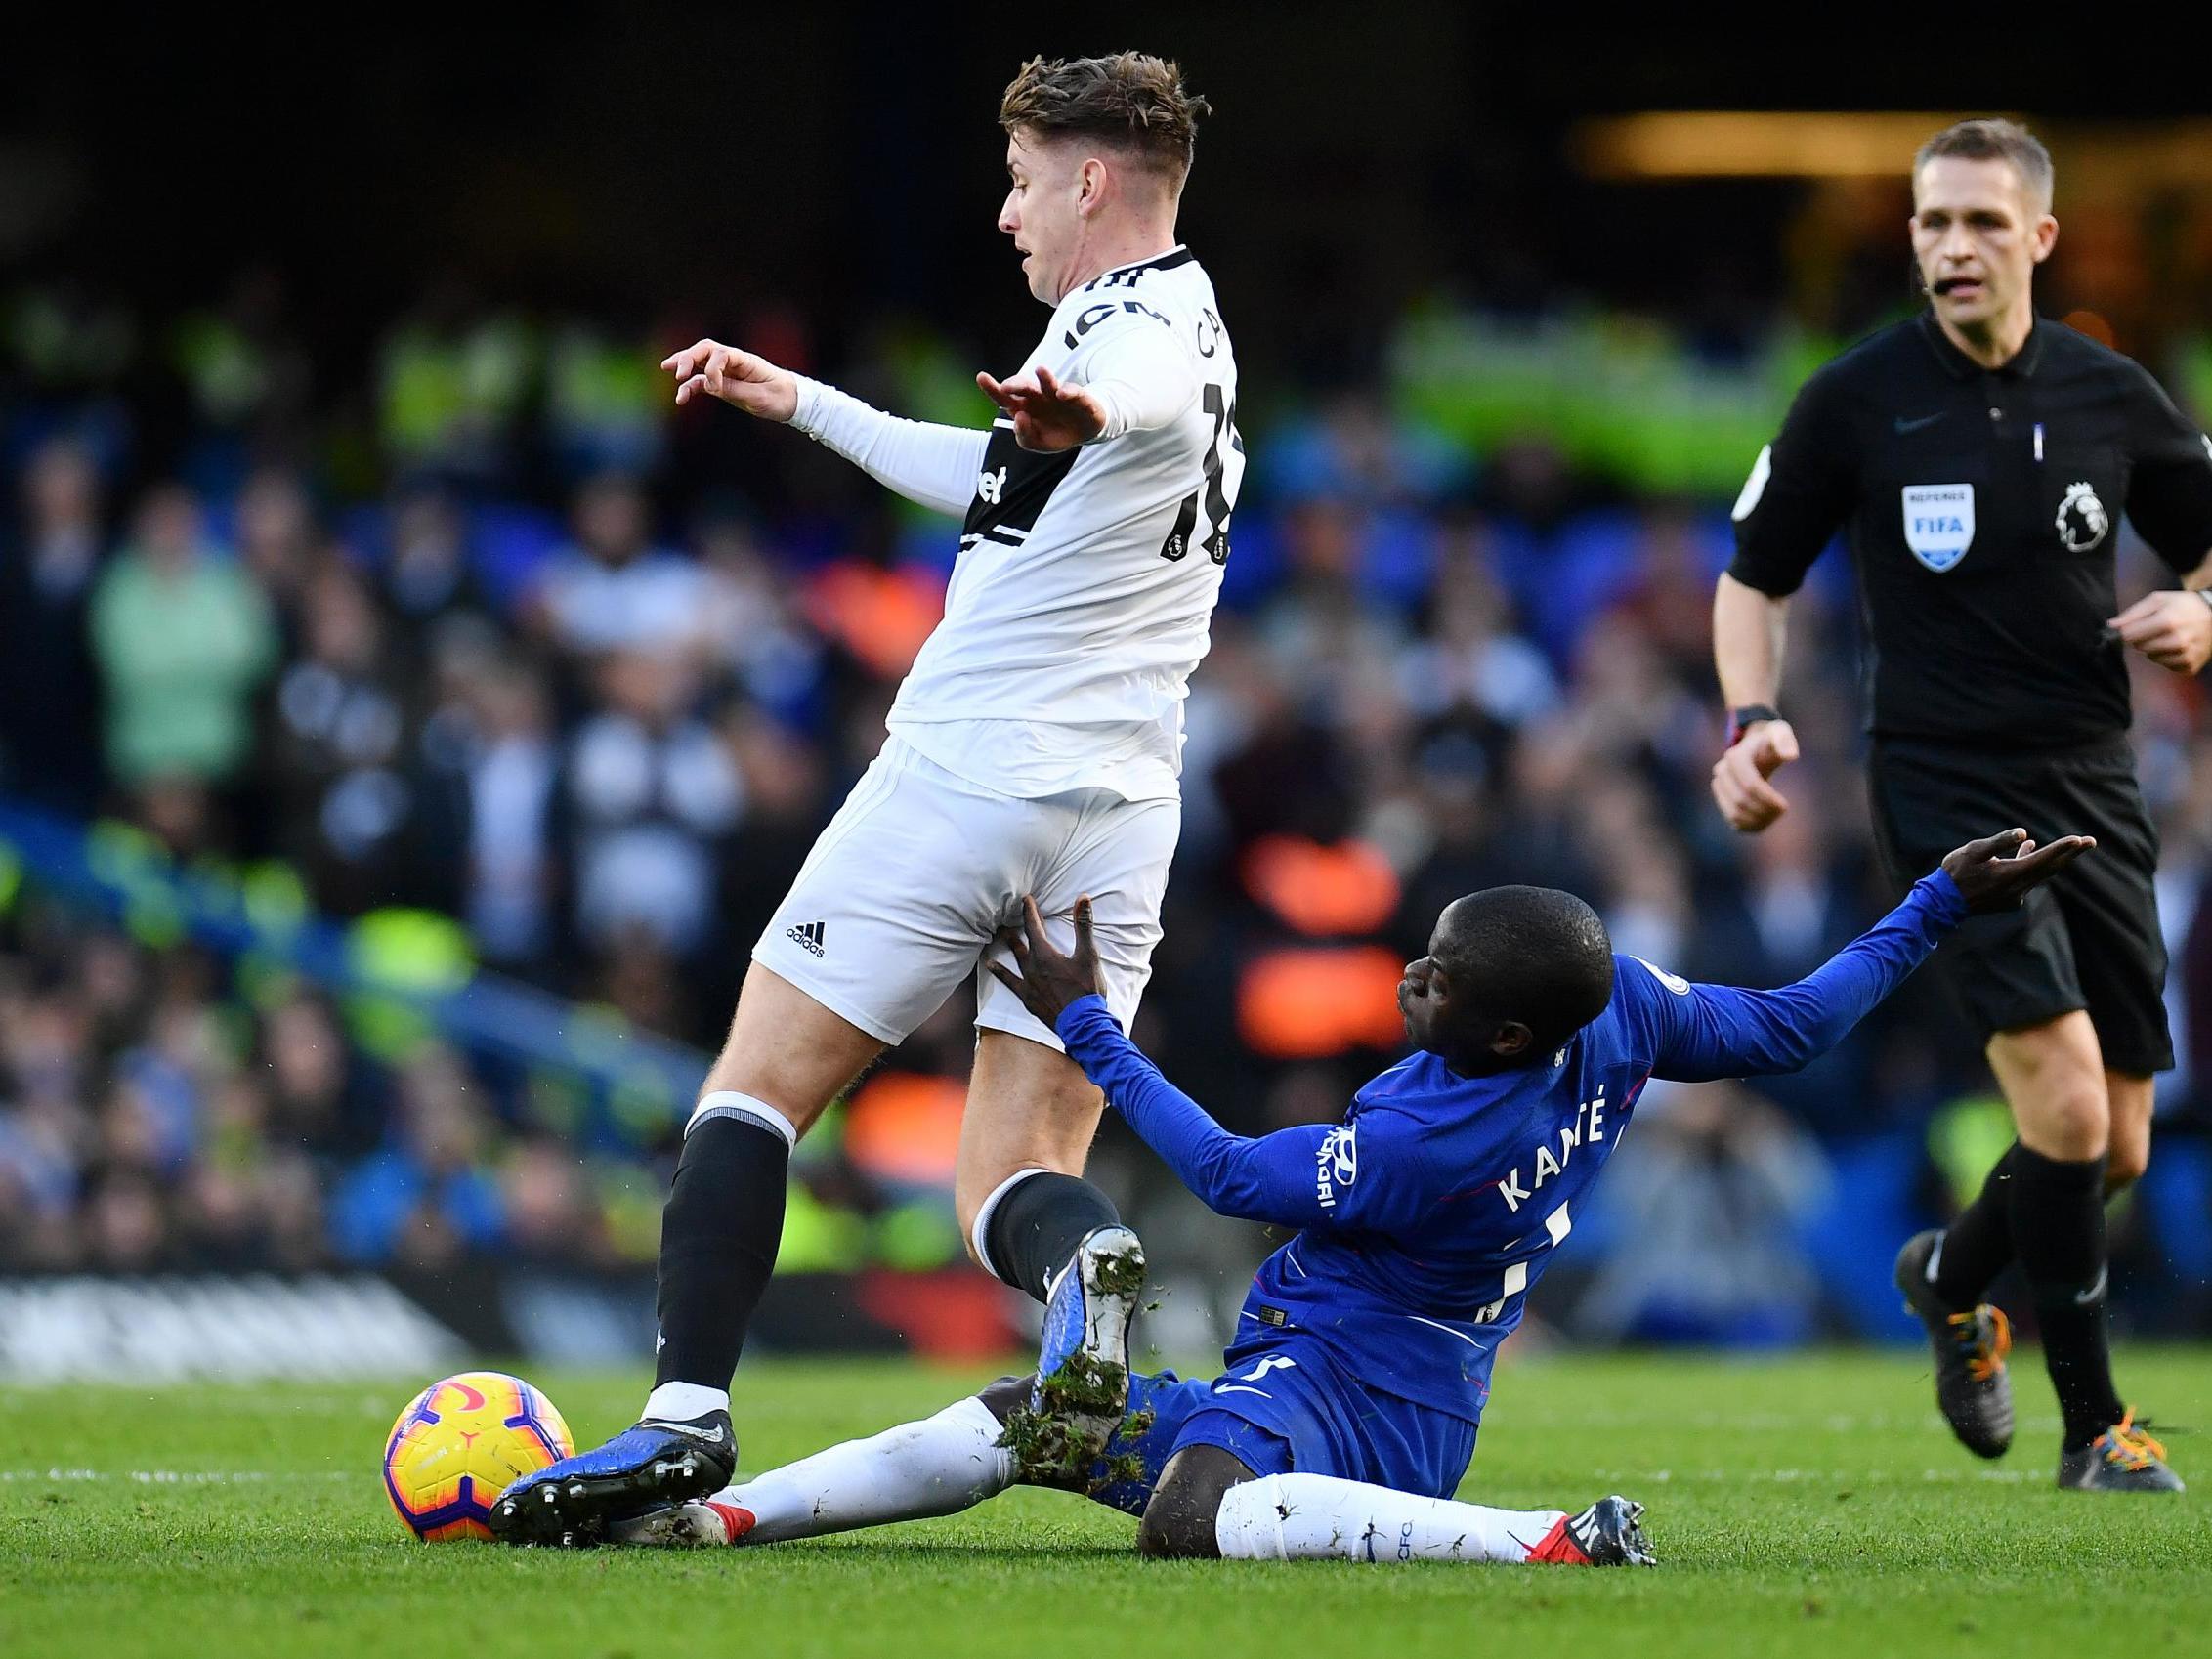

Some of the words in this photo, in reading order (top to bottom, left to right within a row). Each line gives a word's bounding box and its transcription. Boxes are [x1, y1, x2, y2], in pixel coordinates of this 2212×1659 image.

[1915, 516, 1964, 534] FIFA
[787, 928, 825, 958] adidas
[1498, 1084, 1606, 1212] KANTÉ
